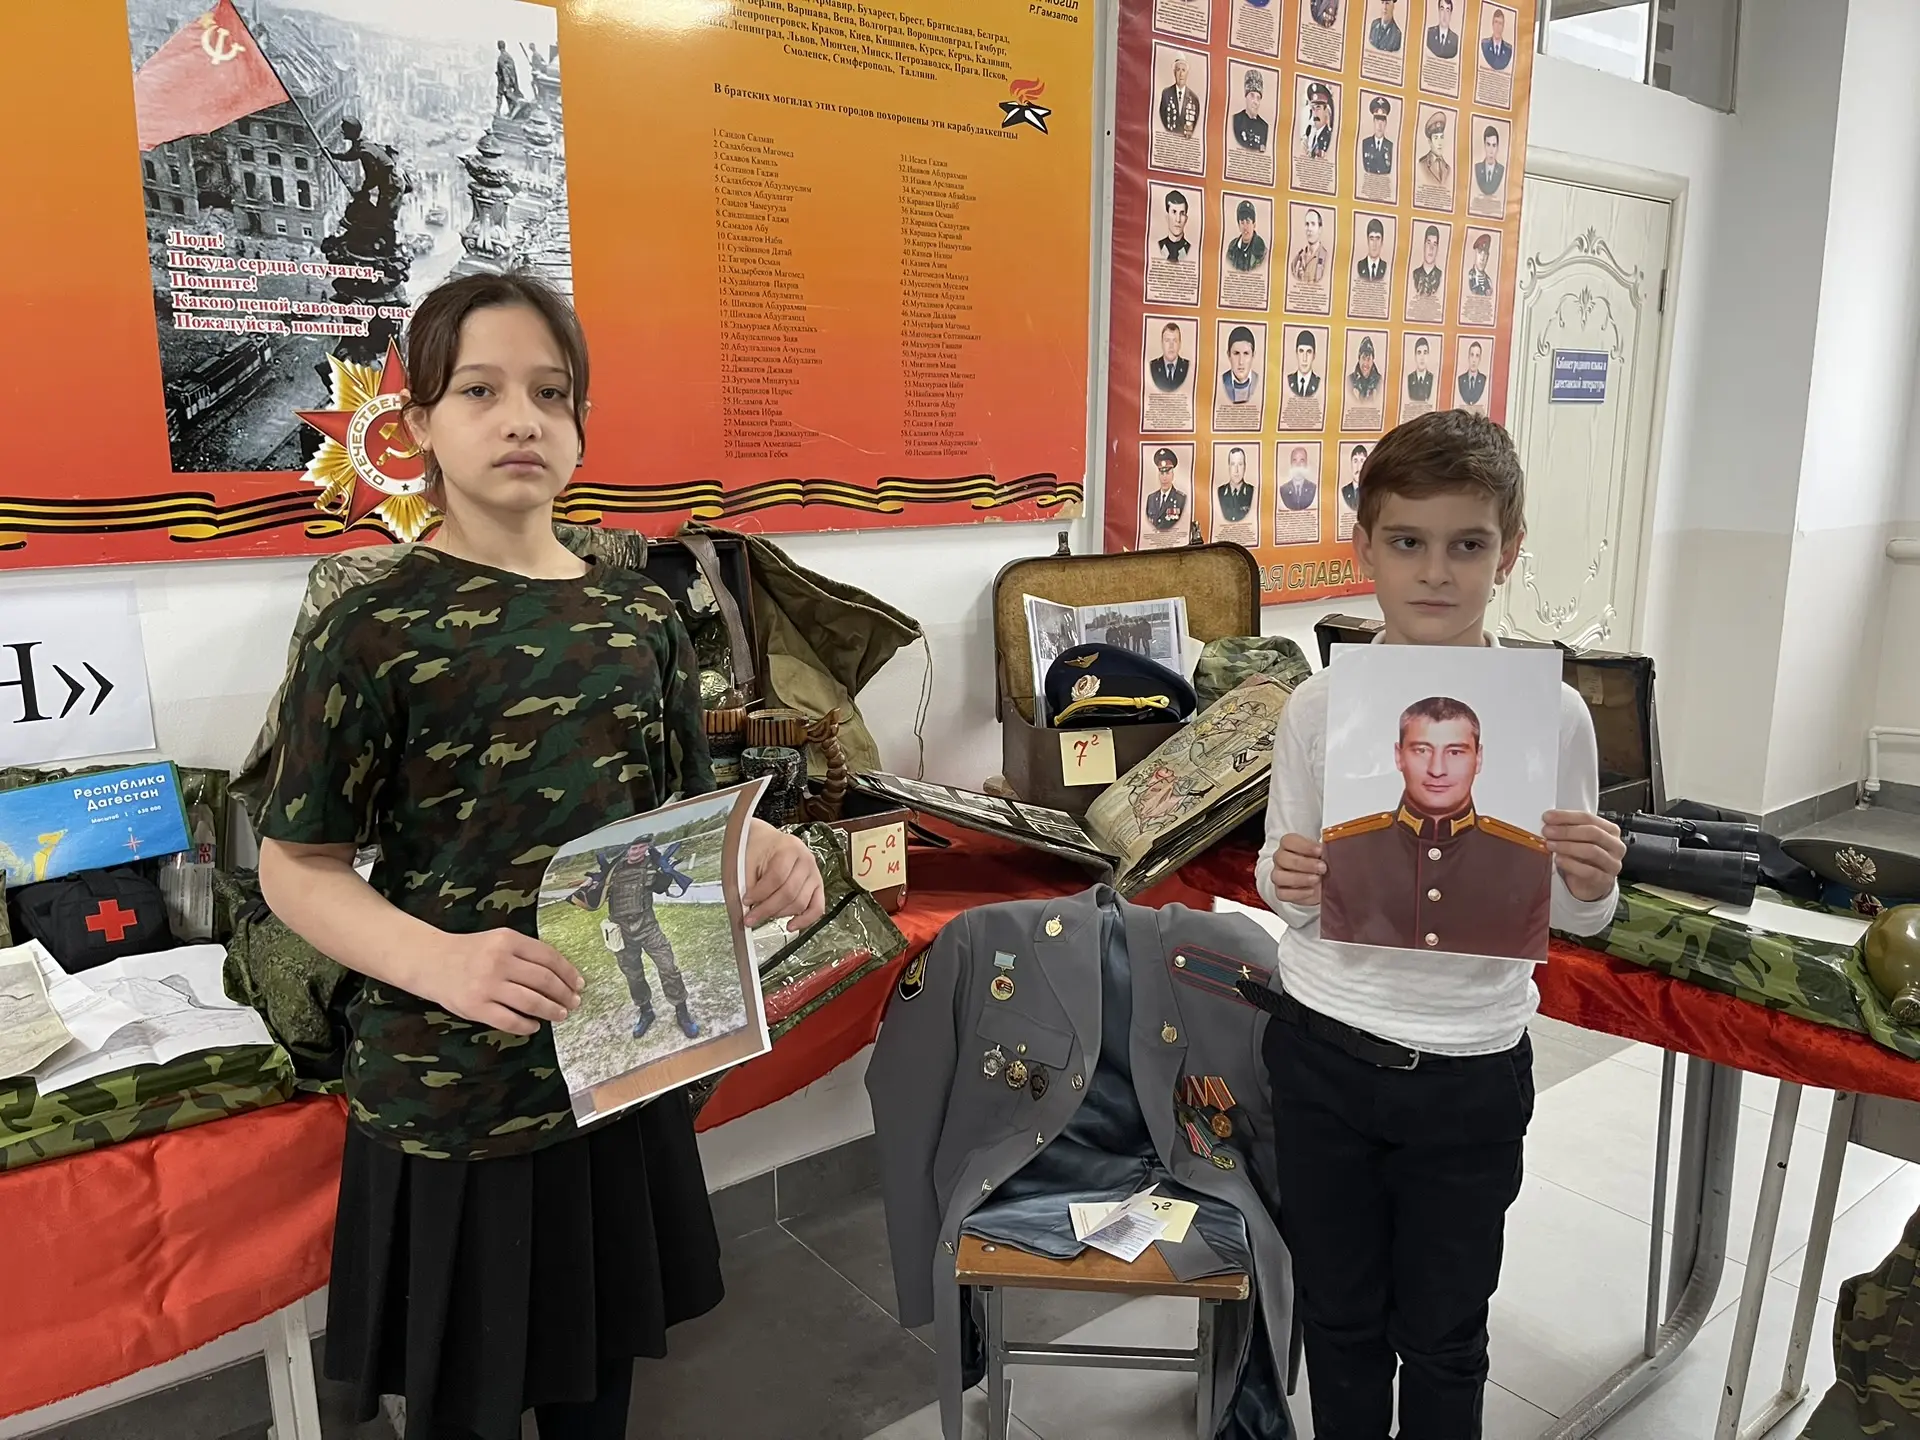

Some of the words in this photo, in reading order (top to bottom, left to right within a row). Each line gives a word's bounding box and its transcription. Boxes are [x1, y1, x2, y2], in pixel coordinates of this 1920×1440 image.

[858, 3, 897, 21] Бухарест,
[900, 12, 924, 26] Брест,
[927, 18, 975, 37] Братислава,
[977, 29, 1009, 44] Белград,
[1029, 4, 1078, 23] Р.Гамзатов
[788, 3, 830, 21] Варшава,
[833, 14, 856, 26] Вена,
[859, 18, 904, 36] Волгоград,
[907, 28, 972, 49] Ворошиловград,
[975, 41, 1007, 56] Гамбург,
[730, 20, 785, 40] Ленинград,
[787, 32, 818, 46] Львов,
[820, 37, 859, 53] Мюнхен,
[862, 45, 893, 60] Минск,
[895, 52, 952, 72] Петрозаводск,
[954, 63, 980, 76] Прага,
[983, 67, 1008, 81] Псков,
[812, 22, 847, 38] Краков,
[850, 28, 873, 43] Киев,
[876, 35, 917, 52] Кишинев,
[920, 44, 946, 57] Курск,
[949, 49, 974, 62] Керчь,
[976, 54, 1012, 69] Калинин,
[784, 44, 830, 62] Смоленск,
[832, 54, 895, 74] Симферополь,
[714, 83, 721, 93] В
[725, 85, 770, 101] братских
[773, 95, 813, 108] могилах
[816, 102, 836, 111] этих
[838, 106, 874, 117] городов
[877, 111, 929, 126] похоронены
[931, 120, 944, 128] эти
[947, 122, 1018, 140] карабудахкентцы
[167, 230, 224, 250] Люди!
[169, 253, 234, 271] Покуда
[238, 259, 296, 275] сердца
[171, 273, 258, 291] Помните!
[173, 293, 234, 310] Какою
[238, 298, 289, 314] ценой
[293, 303, 376, 318] завоевано
[175, 314, 290, 335] Пожалуйста,
[292, 321, 369, 336] помните!
[1288, 560, 1354, 588] СЛАВА
[74, 773, 166, 799] Республика
[87, 788, 159, 811] Дагестан
